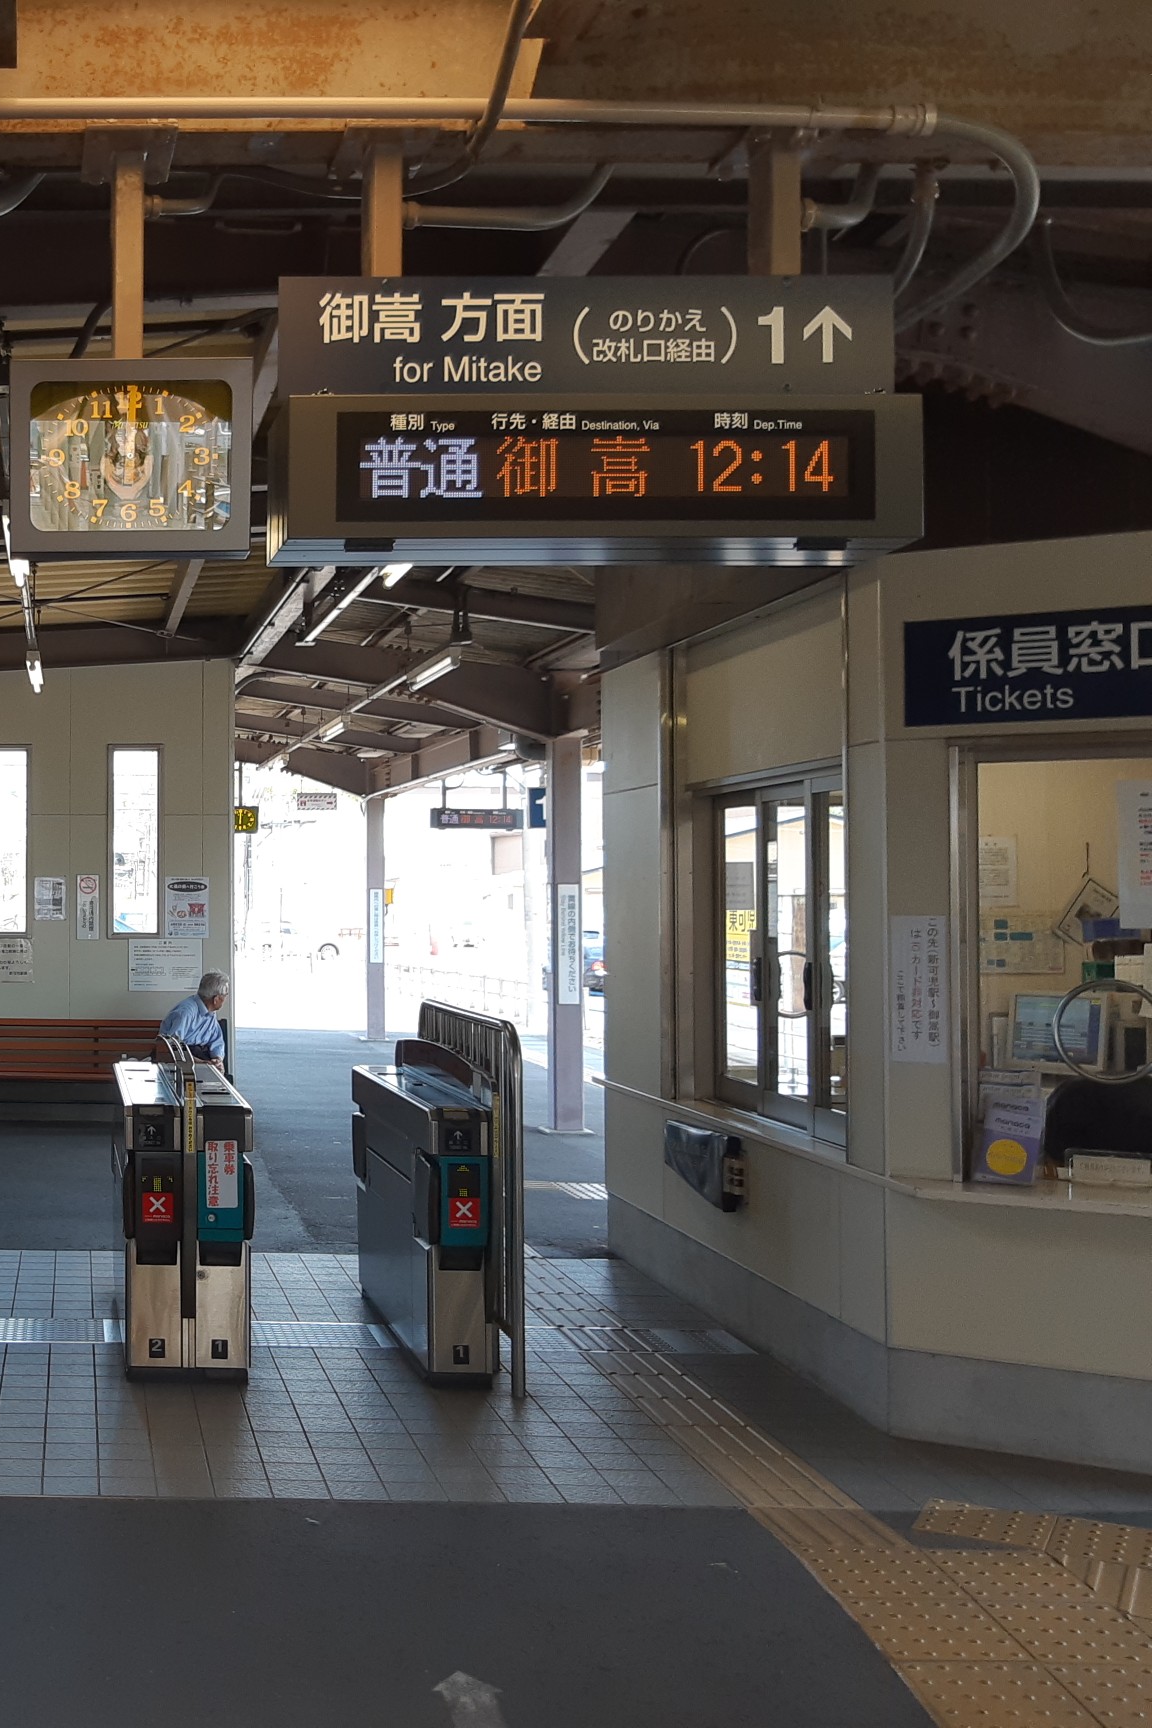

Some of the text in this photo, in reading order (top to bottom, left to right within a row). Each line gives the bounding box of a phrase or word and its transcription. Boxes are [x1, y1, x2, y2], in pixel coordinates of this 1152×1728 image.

[319, 292, 544, 344] 御嵩 方面
[609, 309, 707, 334] のりかえ
[757, 305, 783, 364] 1
[591, 339, 716, 364] 改札口経由
[393, 355, 543, 384] for Mitake
[90, 401, 113, 418] 11
[154, 398, 165, 415] 1
[64, 419, 89, 437] 10
[179, 415, 196, 432] 2
[390, 413, 456, 433] 種別 Type
[491, 412, 660, 433] 行先・経由 Destination, Via
[713, 412, 748, 431] 時刻
[48, 449, 65, 467] 9
[193, 448, 210, 465] 3
[359, 436, 483, 500] 普通
[689, 439, 835, 493] 12:14
[64, 481, 81, 499] 8
[178, 480, 195, 497] 4
[92, 500, 108, 517] 7
[120, 503, 137, 521] 6
[149, 499, 166, 516] 5
[951, 684, 1074, 713] Tickets
[995, 1117, 1030, 1129] manaca
[224, 1142, 235, 1175] 乗車券
[208, 1142, 219, 1206] 取り忘れ注意
[152, 1340, 163, 1353] 2
[215, 1340, 224, 1353] 1
[457, 1345, 466, 1358] 1
